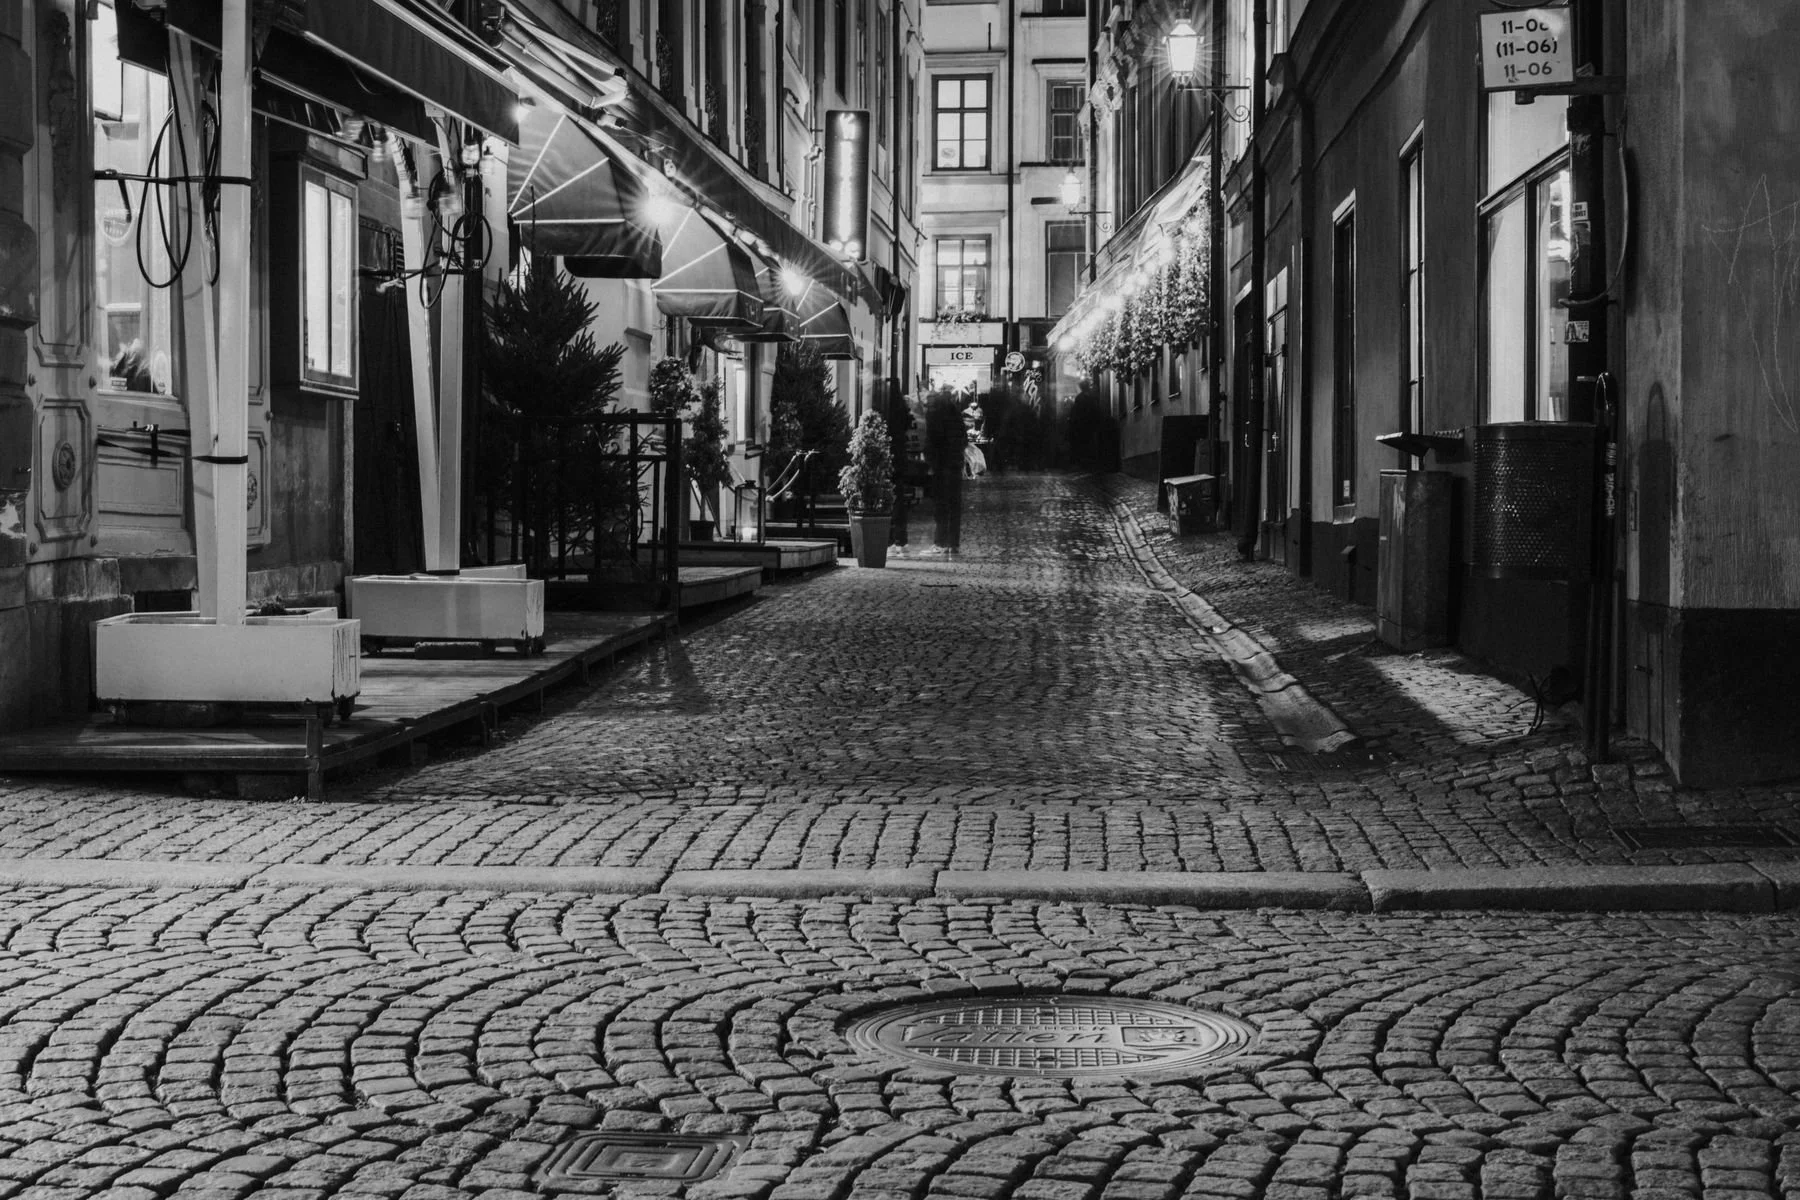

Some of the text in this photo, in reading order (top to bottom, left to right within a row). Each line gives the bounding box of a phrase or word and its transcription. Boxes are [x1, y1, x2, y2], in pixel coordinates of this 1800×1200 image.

[1496, 38, 1558, 57] (11-06)
[1504, 61, 1552, 78] 11-06
[951, 352, 973, 360] ICE
[898, 1024, 1109, 1043] Vatten
